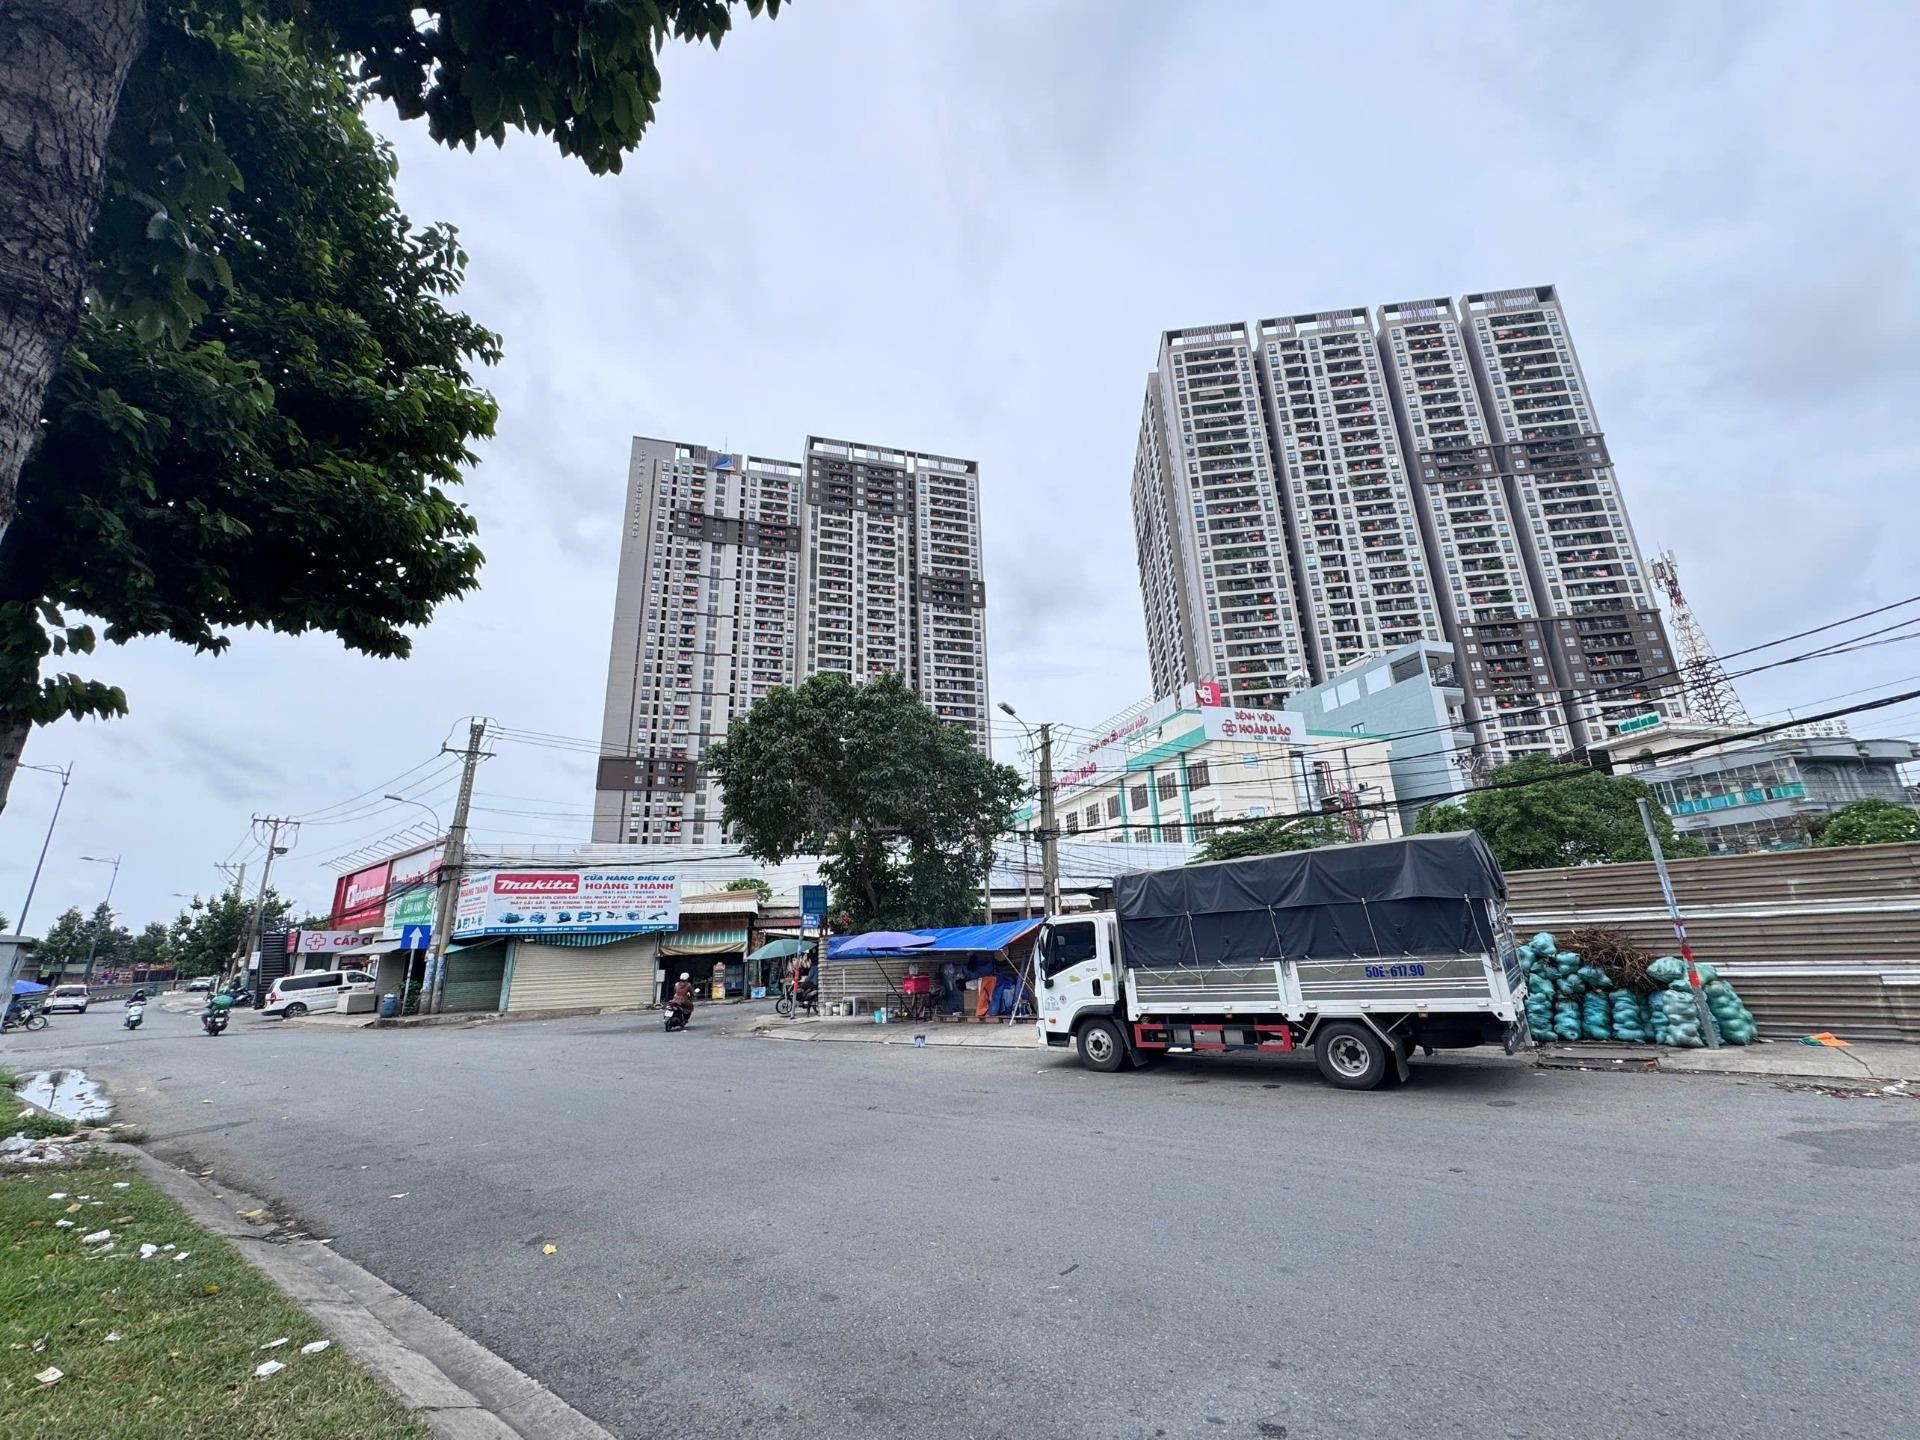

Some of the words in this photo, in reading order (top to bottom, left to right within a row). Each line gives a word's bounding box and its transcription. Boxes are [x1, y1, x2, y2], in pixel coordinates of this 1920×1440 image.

[1235, 710, 1255, 721] BỆNH
[1257, 712, 1275, 722] VIỆN
[1239, 722, 1268, 735] HOÀN
[333, 934, 359, 946] CẤP
